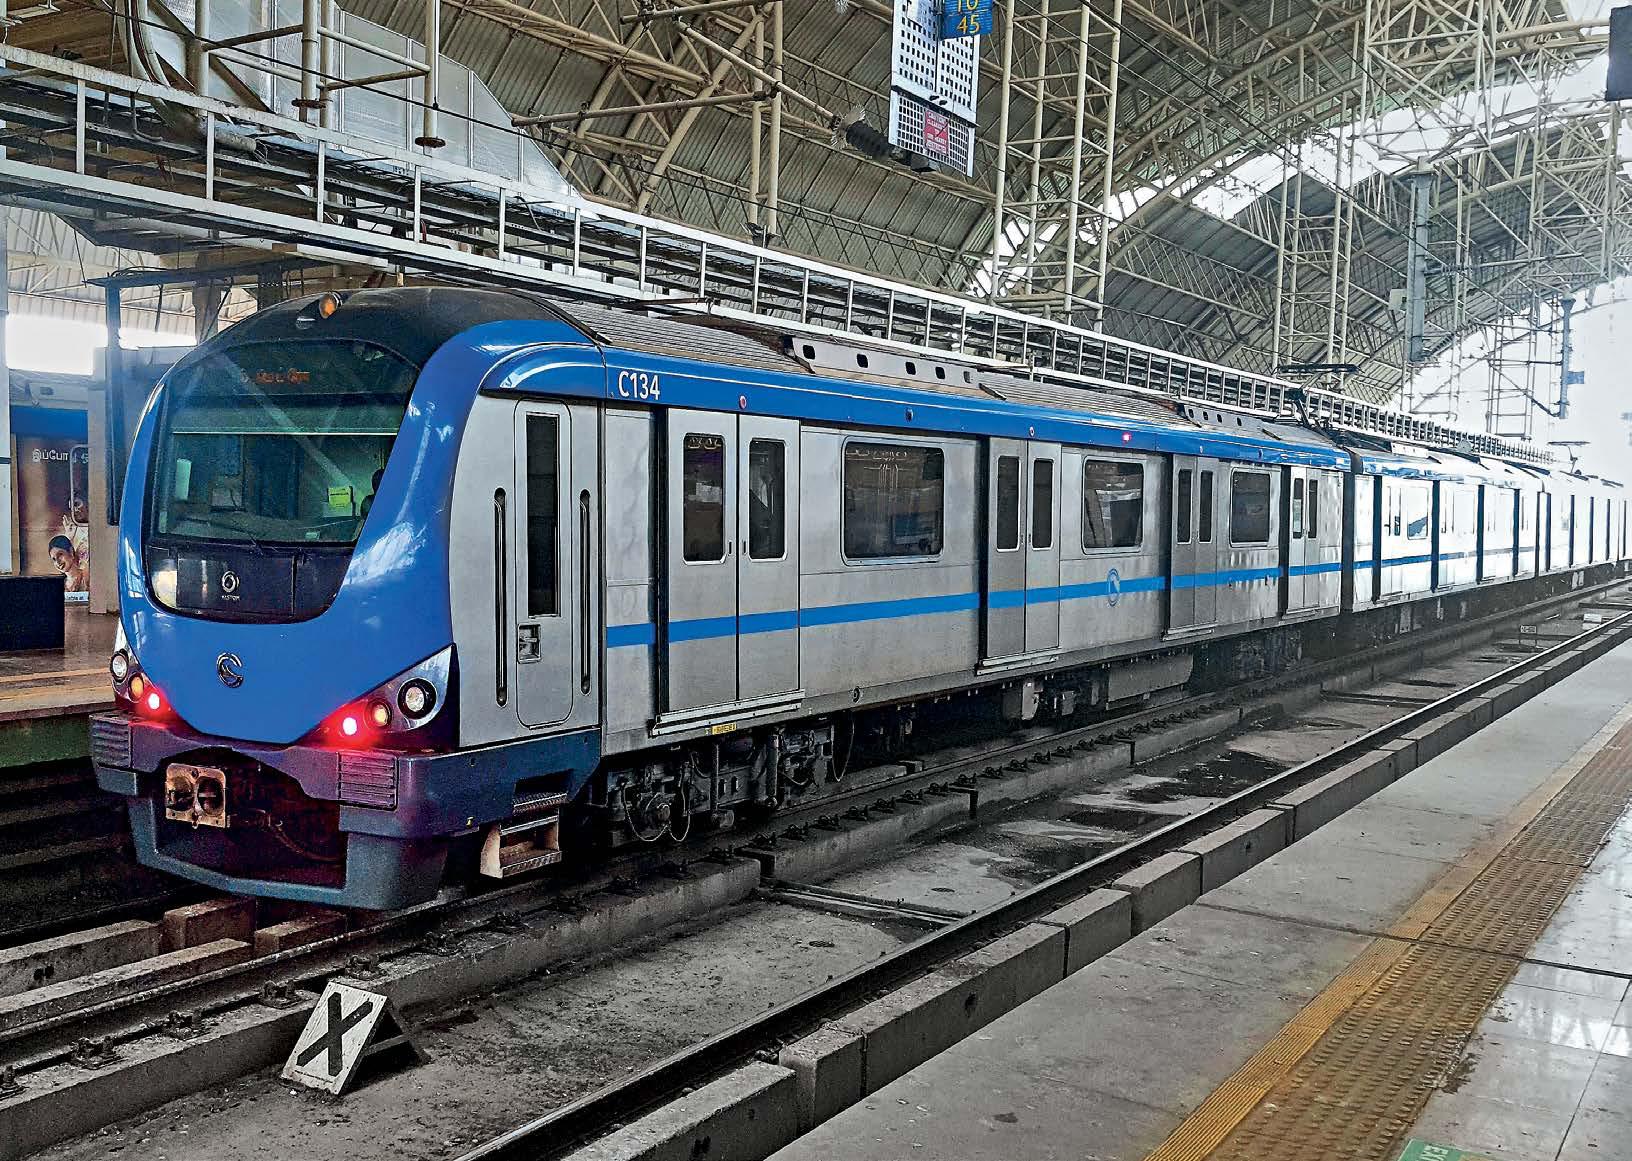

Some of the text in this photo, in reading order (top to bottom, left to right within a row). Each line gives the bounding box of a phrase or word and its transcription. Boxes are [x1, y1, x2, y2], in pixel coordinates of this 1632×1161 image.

[957, 14, 980, 34] 45
[619, 371, 660, 400] C134
[1416, 1145, 1449, 1161] EXI
